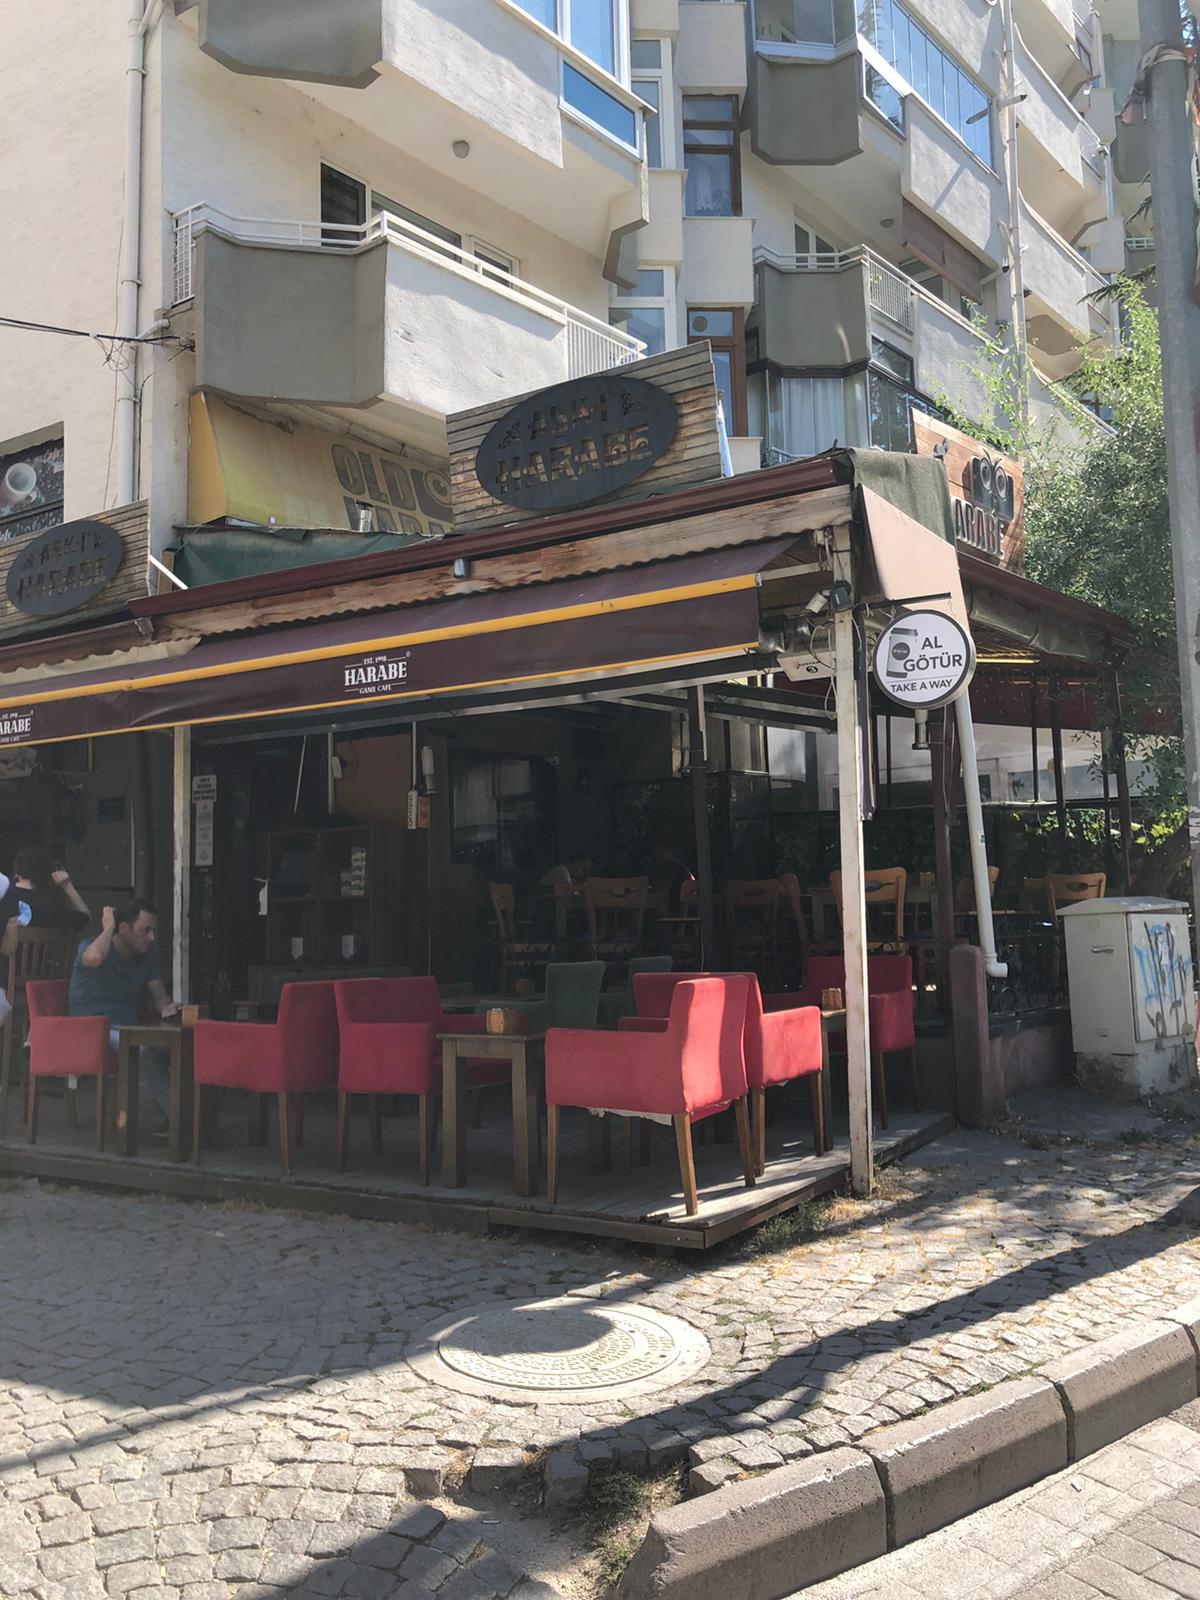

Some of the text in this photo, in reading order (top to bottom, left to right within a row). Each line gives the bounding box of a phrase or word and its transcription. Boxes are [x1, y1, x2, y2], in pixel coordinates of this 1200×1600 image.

[496, 424, 652, 494] HARABE
[332, 444, 416, 511] OLD
[921, 635, 943, 650] AL
[903, 651, 963, 672] GÖTÜR
[344, 662, 407, 686] HARABE
[890, 679, 953, 693] TAKE A WAY
